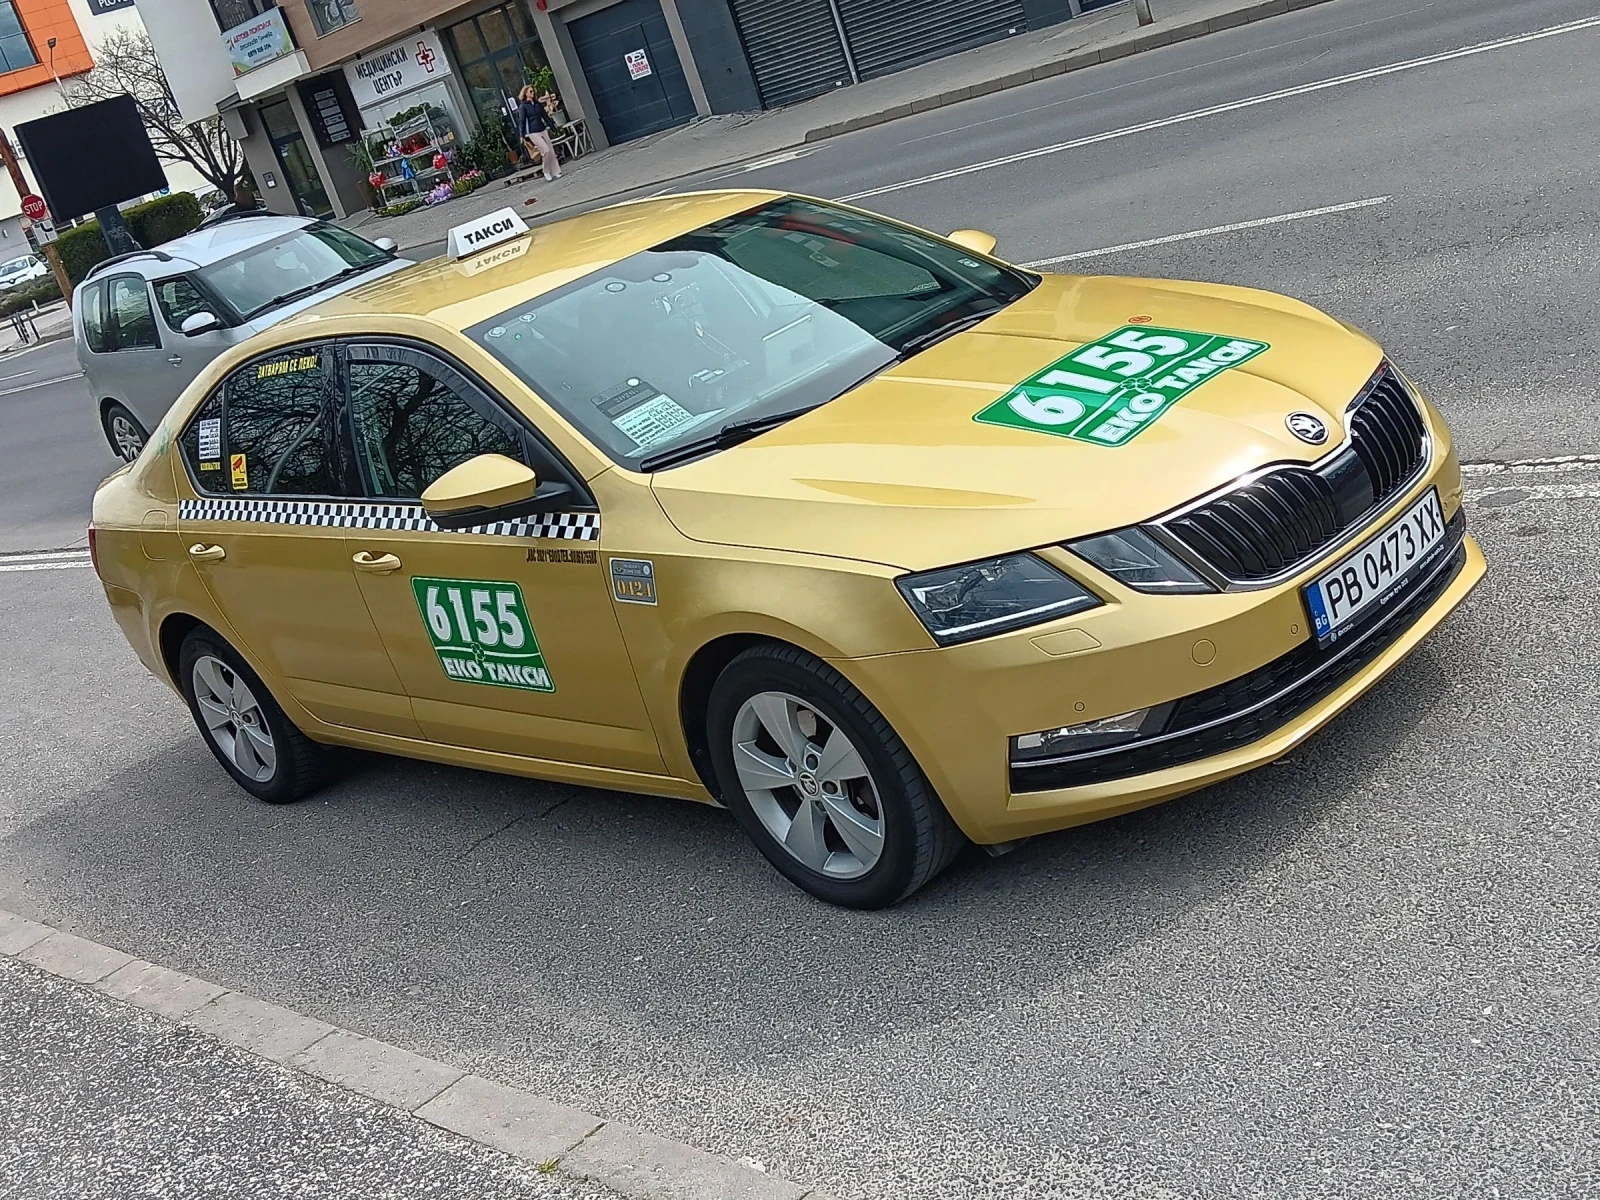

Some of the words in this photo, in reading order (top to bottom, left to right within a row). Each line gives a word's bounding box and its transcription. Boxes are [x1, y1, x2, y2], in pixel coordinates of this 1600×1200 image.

[355, 46, 408, 79] МЕДИЦИНСКИ
[372, 70, 403, 95] ЦЕНТЪР
[24, 200, 43, 215] STOP
[463, 218, 514, 245] ТАКСИ
[289, 358, 298, 372] СЕ
[1006, 330, 1190, 426] 6155
[1088, 392, 1166, 443] ЕКО
[1152, 340, 1261, 390] ТАКСИ
[1363, 523, 1416, 590] 0473
[617, 579, 652, 598] 0424
[426, 586, 525, 648] 6155
[1315, 614, 1328, 630] BG
[441, 656, 483, 679] ЕКО
[483, 661, 552, 688] ТАКСИ
